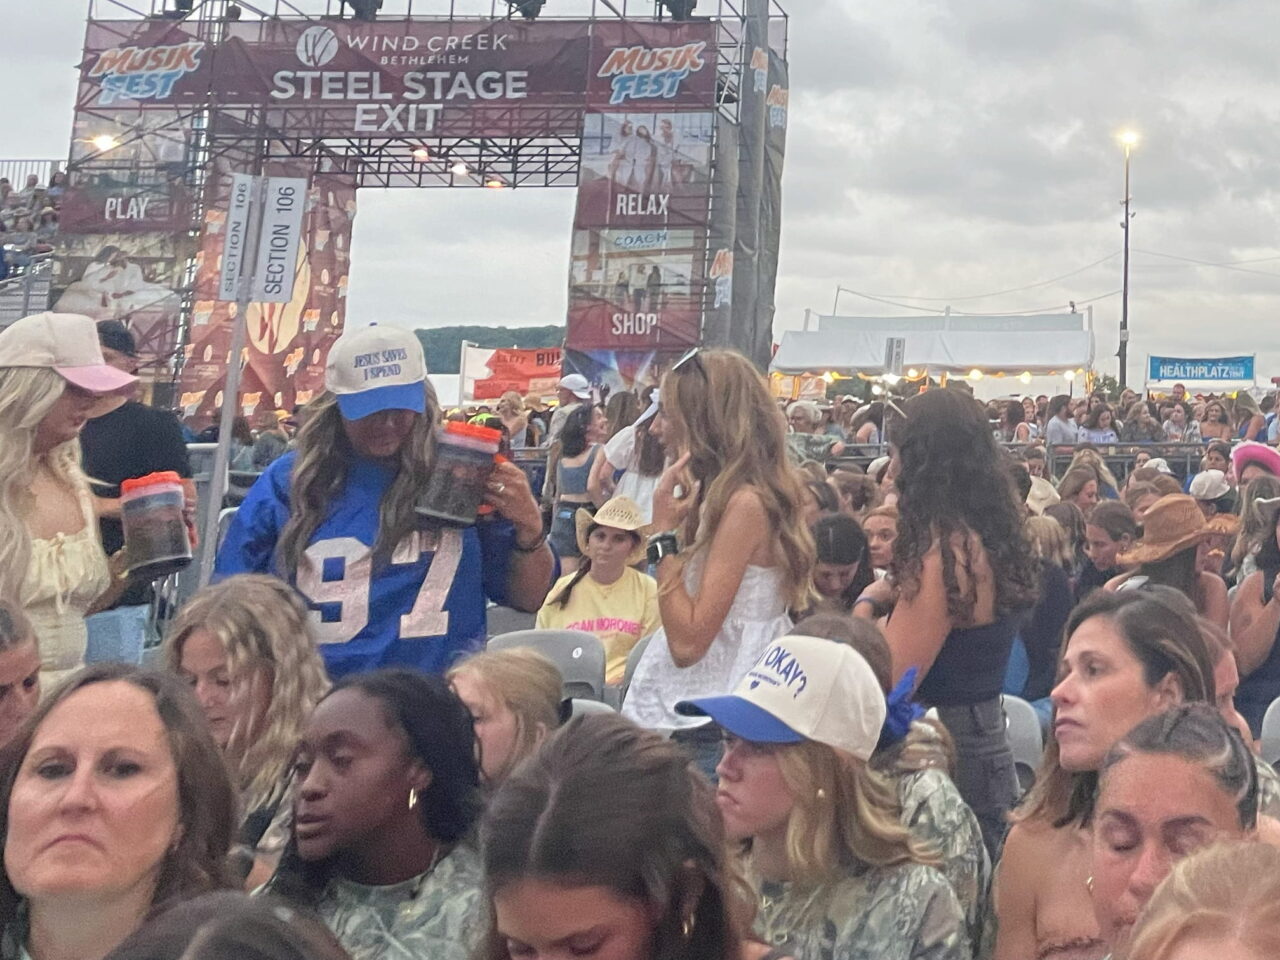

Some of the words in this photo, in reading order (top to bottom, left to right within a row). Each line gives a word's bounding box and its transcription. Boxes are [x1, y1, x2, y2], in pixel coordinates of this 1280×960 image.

[346, 34, 420, 52] WIND
[427, 33, 507, 52] CREEK
[88, 41, 204, 77] MUSIK
[380, 54, 470, 65] BETHLEHEM
[597, 41, 706, 77] MUSIK
[98, 68, 185, 105] FEST
[270, 71, 393, 100] STEEL
[401, 70, 529, 100] STAGE
[610, 69, 690, 105] FEST
[353, 103, 444, 132] EXIT
[105, 197, 150, 220] PLAY
[276, 186, 296, 213] 106
[615, 193, 670, 215] RELAX
[614, 231, 667, 246] COACH
[225, 221, 242, 292] SECTION
[264, 224, 291, 294] SECTION
[611, 312, 657, 335] SHOP
[353, 351, 381, 369] JESUS
[382, 347, 408, 363] SAVES
[363, 368, 369, 381] I
[370, 363, 402, 378] SPEND
[1159, 365, 1230, 379] HEALTHPLATZ
[296, 527, 464, 645] 97
[764, 646, 807, 700] OKAY?
